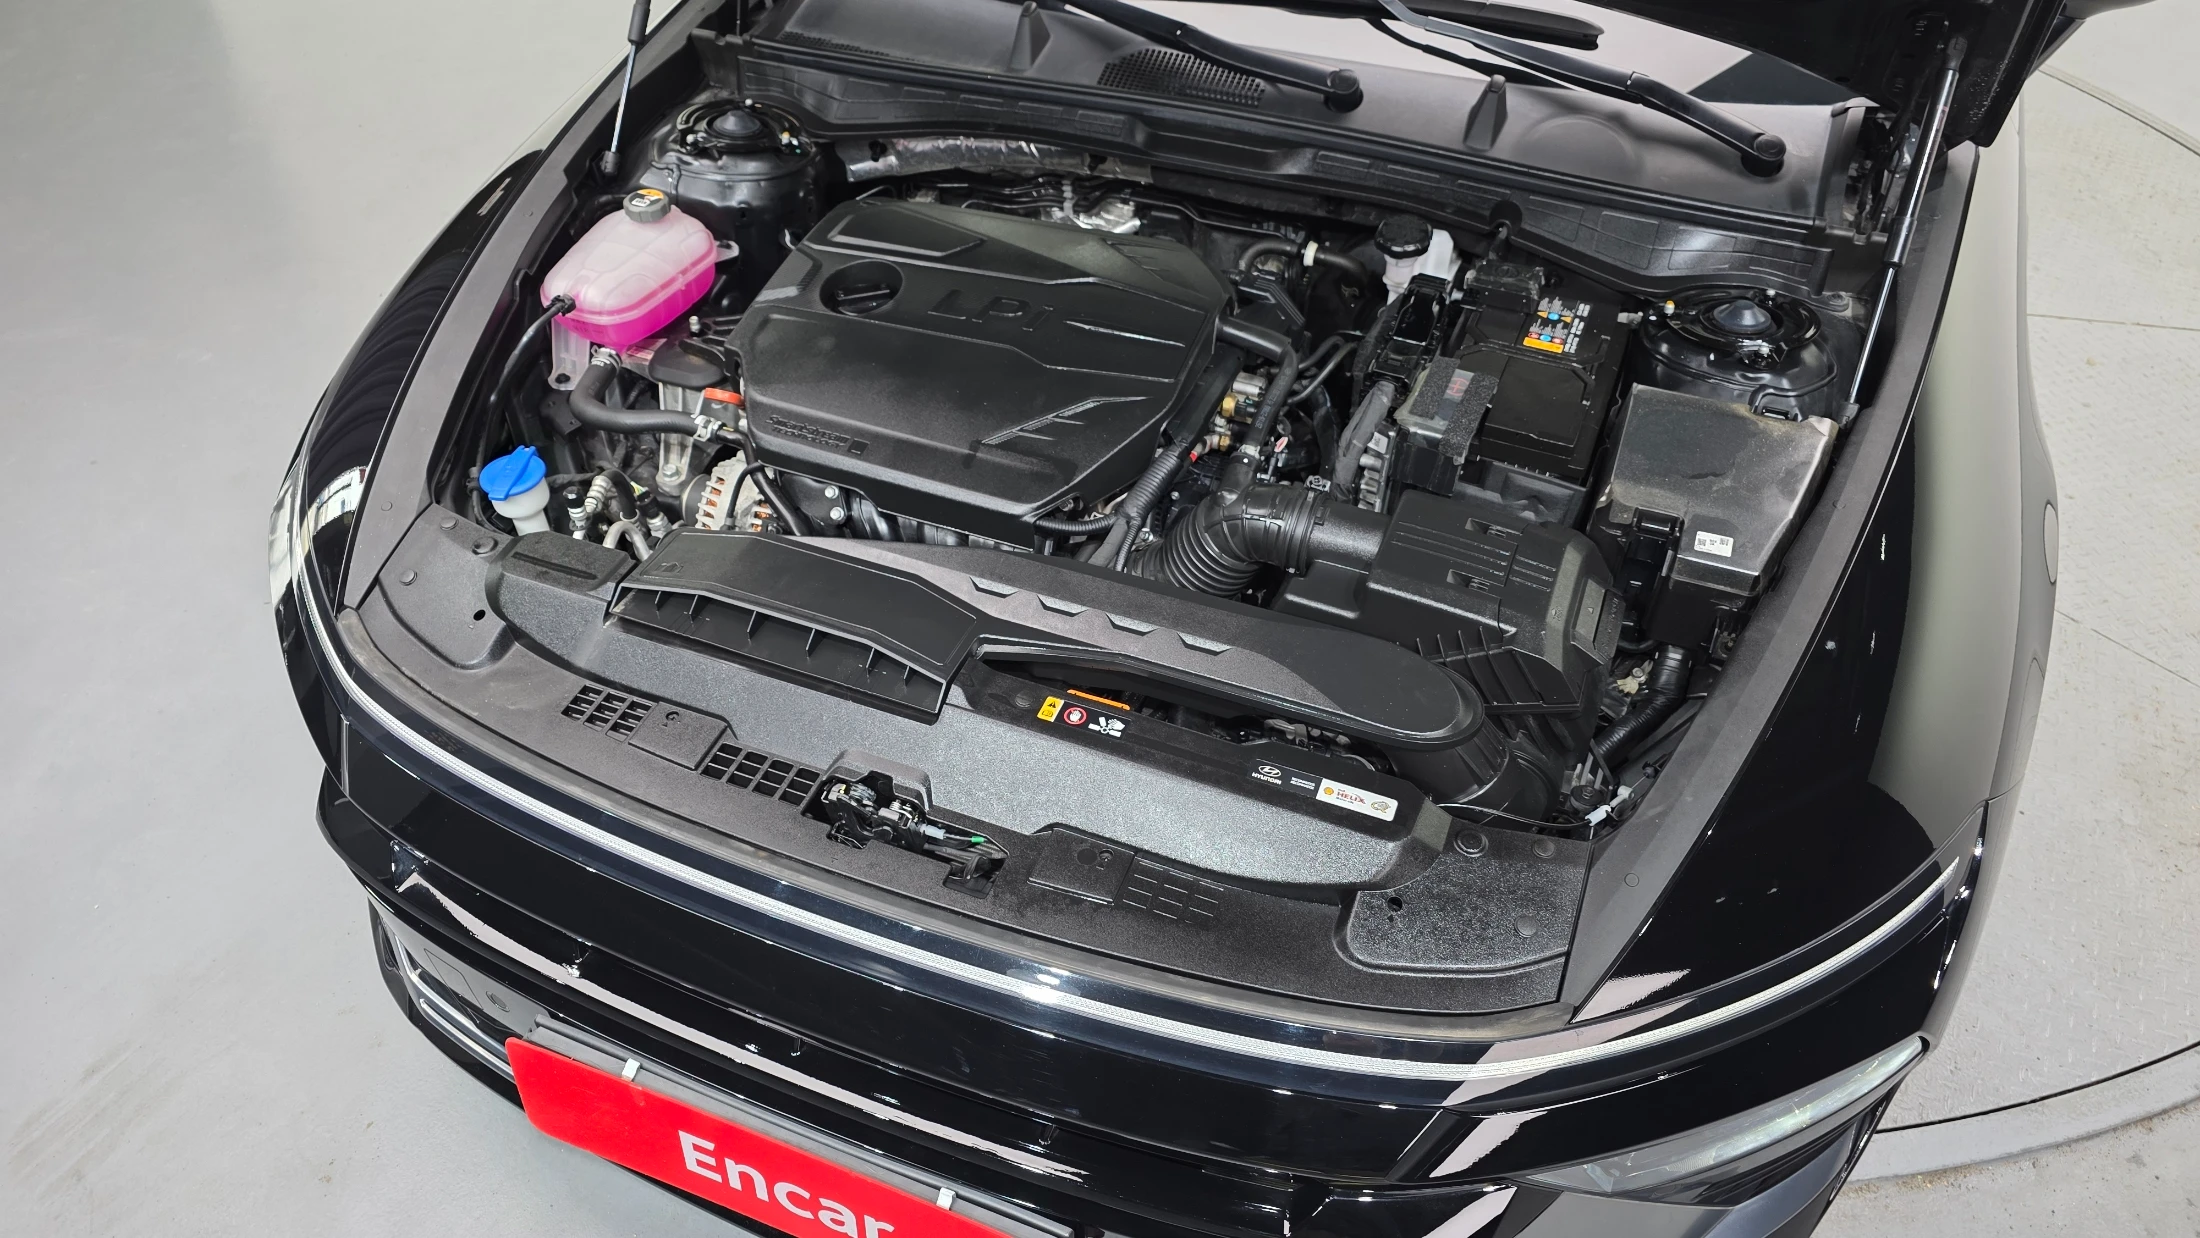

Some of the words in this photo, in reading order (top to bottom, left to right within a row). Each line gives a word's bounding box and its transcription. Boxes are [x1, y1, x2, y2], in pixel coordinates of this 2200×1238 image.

[928, 289, 1053, 331] LPi
[766, 415, 851, 443] Smartstream
[772, 425, 846, 448] TECHNOLOGY
[1251, 772, 1282, 785] HYUNDAI
[1337, 791, 1366, 804] HELIX
[678, 1130, 895, 1238] Encar
